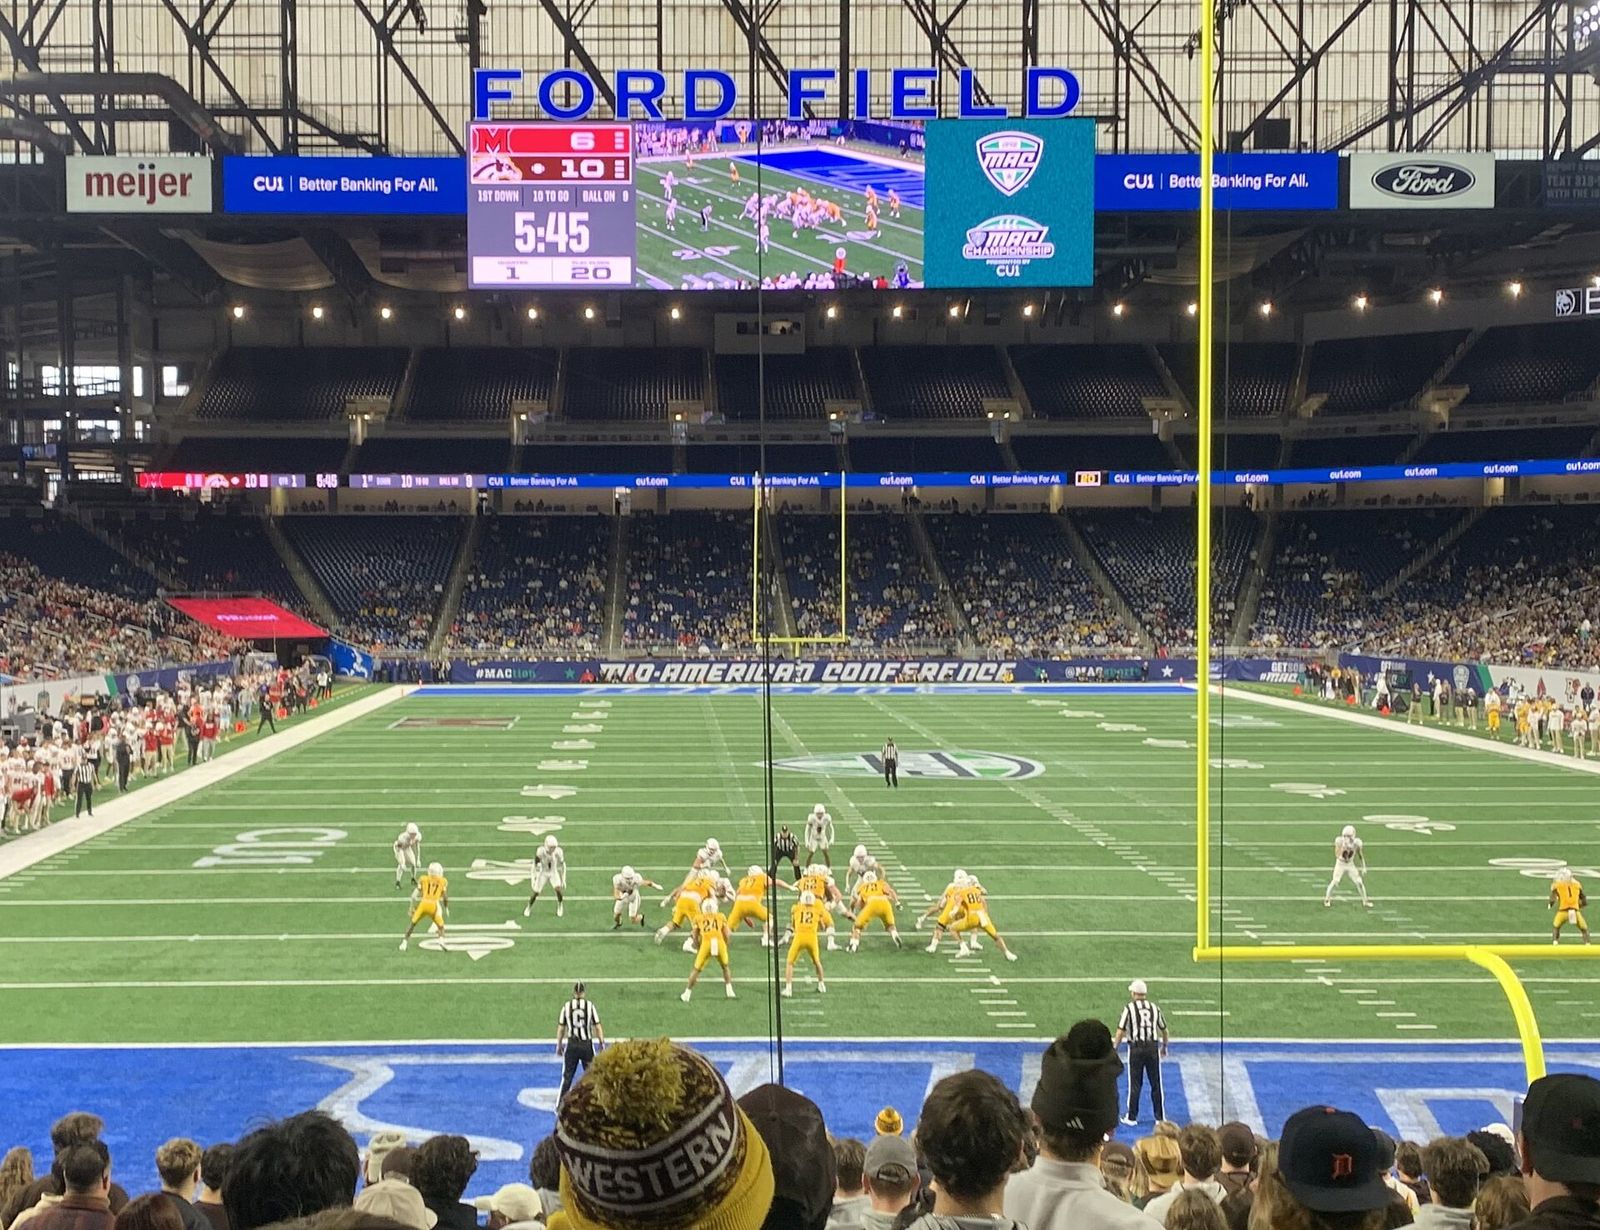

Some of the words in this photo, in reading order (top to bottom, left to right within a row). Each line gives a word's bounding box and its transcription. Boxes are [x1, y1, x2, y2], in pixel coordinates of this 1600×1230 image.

[474, 68, 738, 121] FORD
[787, 67, 1082, 120] FIELD
[570, 131, 595, 151] 6
[984, 152, 1037, 169] MAC
[561, 159, 604, 178] 10
[85, 163, 192, 205] meijer
[253, 175, 284, 192] CU1
[299, 176, 338, 191] Better
[340, 176, 391, 194] Banking
[394, 177, 416, 191] For
[418, 177, 438, 191] All.
[1123, 174, 1154, 189] CU1
[1169, 174, 1203, 188] Bette
[1211, 174, 1260, 190] Banking
[1264, 173, 1287, 187] For
[1289, 173, 1309, 187] All.
[1392, 165, 1455, 193] Ford
[478, 190, 493, 202] 1ST
[494, 190, 519, 202] DOWN
[533, 190, 543, 202] 10
[545, 190, 557, 202] TO
[558, 190, 569, 202] GO
[583, 190, 602, 202] BALL
[604, 190, 615, 202] ON
[514, 211, 590, 253] 5:45
[985, 230, 1043, 248] MAC
[965, 246, 1052, 256] CHAMPIONSHIP
[506, 267, 519, 280] 1
[571, 267, 611, 280] 20
[996, 265, 1020, 277] CU1
[1329, 470, 1362, 480] cu1.com
[1404, 467, 1437, 477] cu1.com
[1483, 464, 1518, 474] cu1.com
[401, 474, 413, 488] 10
[488, 476, 504, 486] CU1
[510, 476, 529, 486] Better
[531, 476, 555, 488] Banking
[557, 477, 567, 486] For
[636, 477, 668, 487] cu1.com
[730, 477, 745, 486] CU1
[772, 477, 796, 487] Banking
[797, 477, 808, 486] For
[880, 476, 913, 486] cu1.com
[970, 475, 985, 484] CU1
[992, 475, 1010, 484] Better
[1012, 475, 1037, 485] Banking
[1038, 475, 1049, 484] For
[1114, 474, 1130, 483] CU1
[1136, 474, 1155, 483] Better
[1157, 474, 1181, 484] Banking
[1183, 474, 1193, 483] For
[1235, 473, 1269, 483] cu1.com
[475, 667, 536, 680] #MACtion
[600, 663, 815, 683] MID-AMERICAN
[821, 663, 1017, 683] CONFERENCE
[427, 882, 439, 896] 17
[800, 911, 814, 925] 12
[702, 919, 719, 932] 24
[1139, 1008, 1152, 1028] R
[565, 1110, 732, 1200] WESTERN
